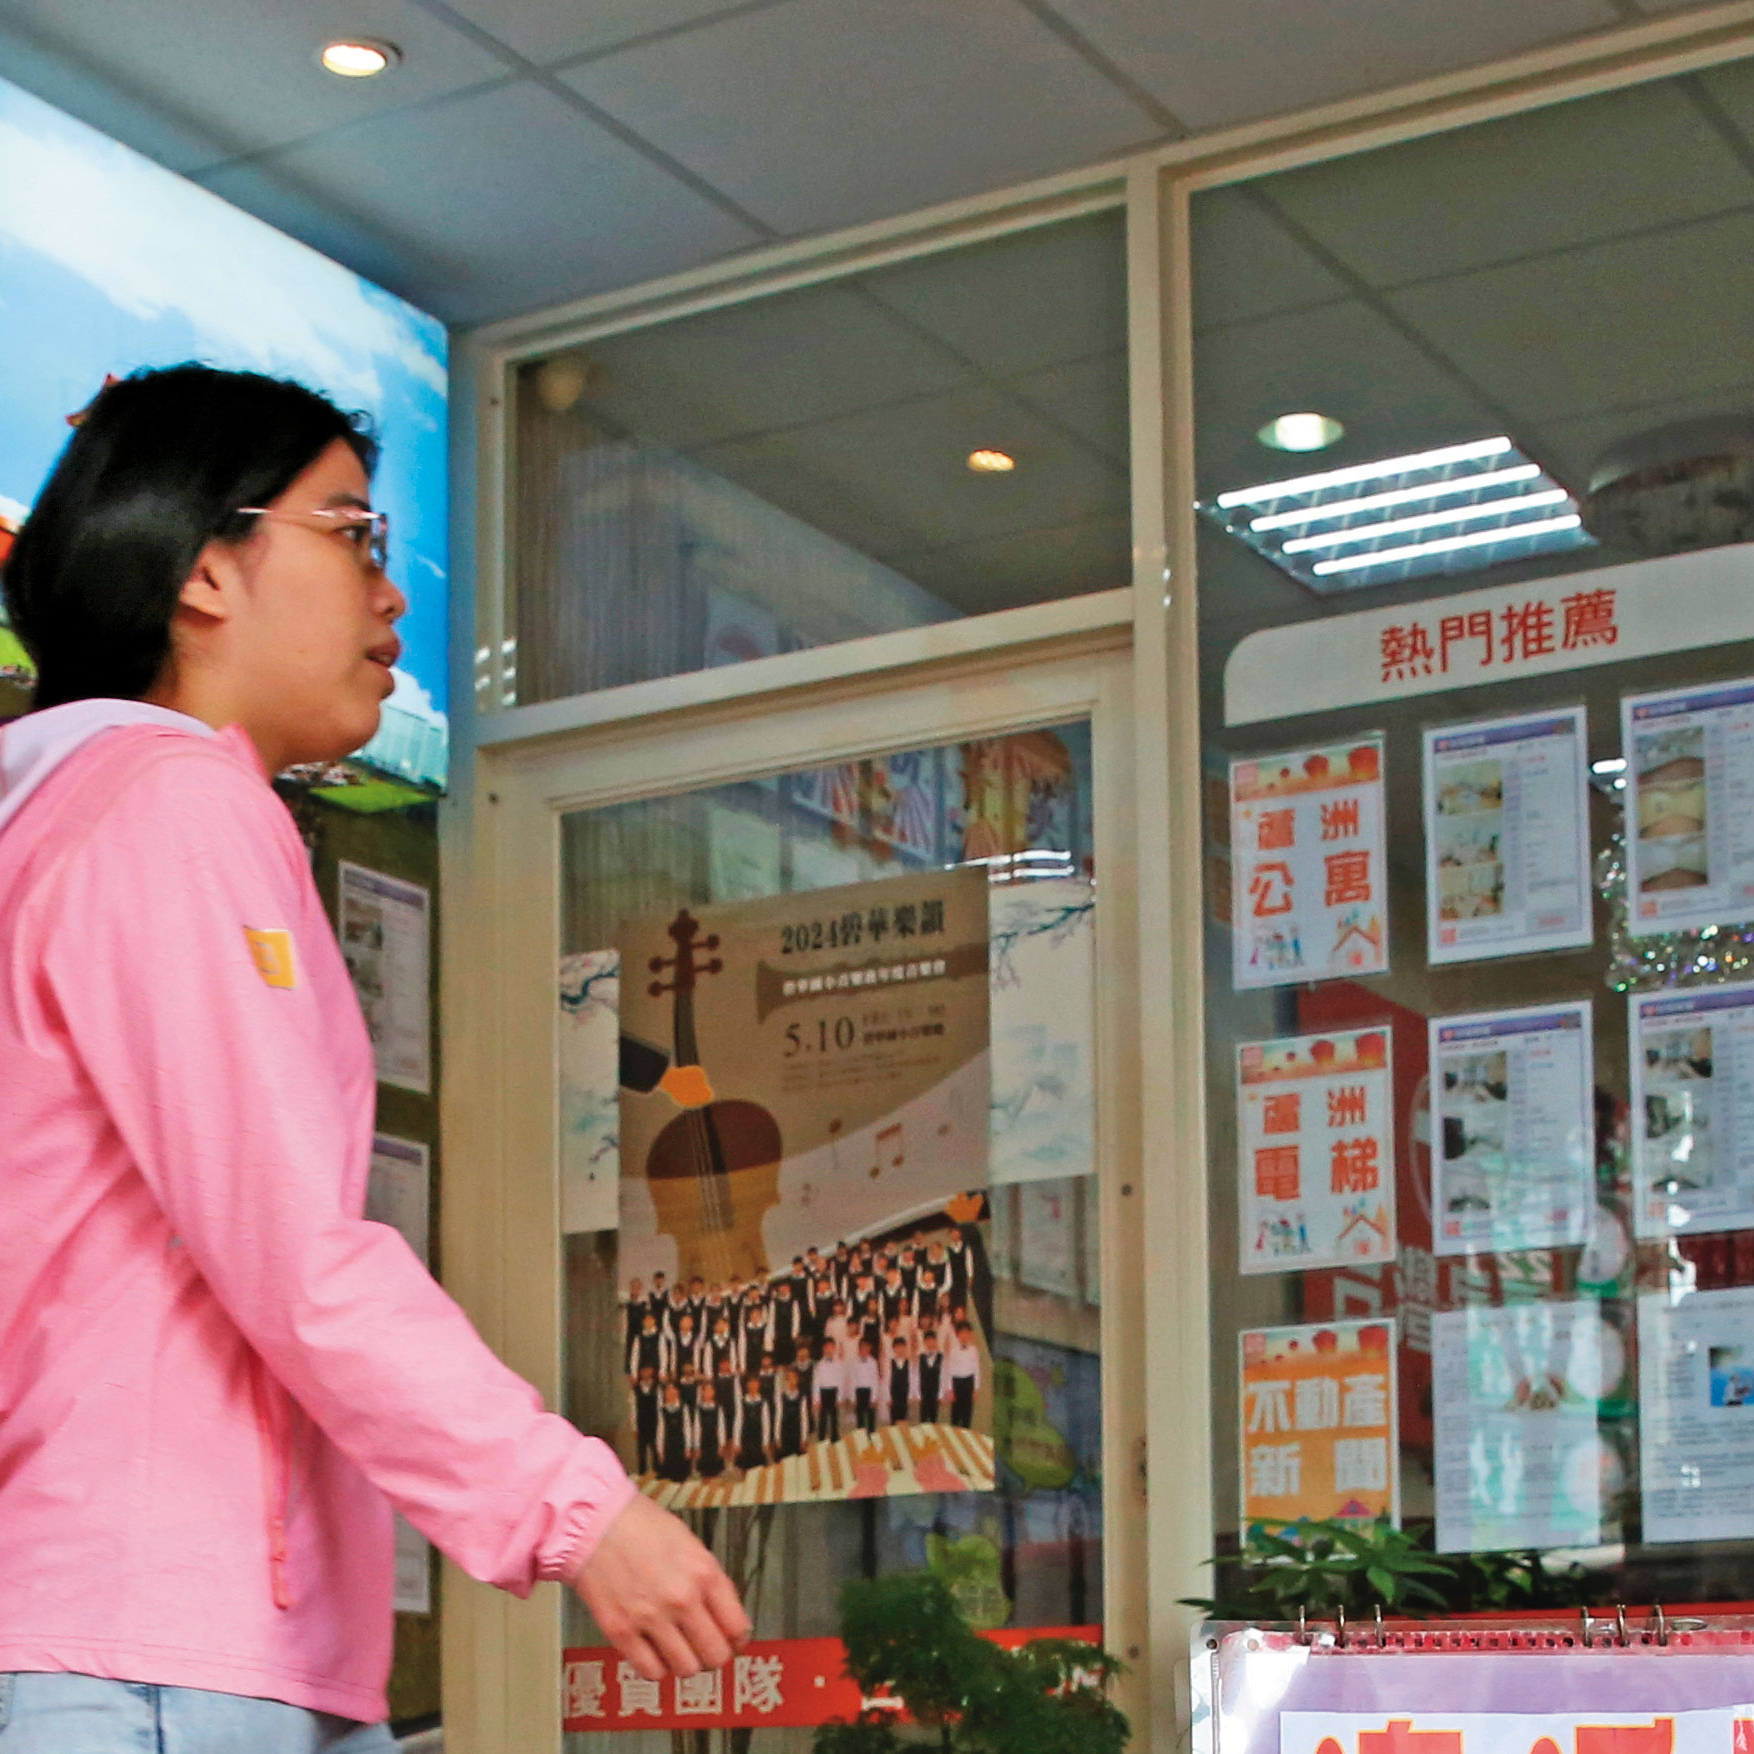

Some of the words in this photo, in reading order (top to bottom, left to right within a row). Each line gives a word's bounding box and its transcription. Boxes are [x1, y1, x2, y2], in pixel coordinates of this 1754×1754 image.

[1379, 587, 1618, 684] 熱門推薦
[1256, 798, 1361, 852] 蘆洲
[1248, 848, 1373, 918] 公寓
[783, 1016, 855, 1058] 5.10
[1253, 1137, 1382, 1203] 電梯
[1246, 1374, 1388, 1433] 不動產
[1249, 1436, 1388, 1497] 新聞
